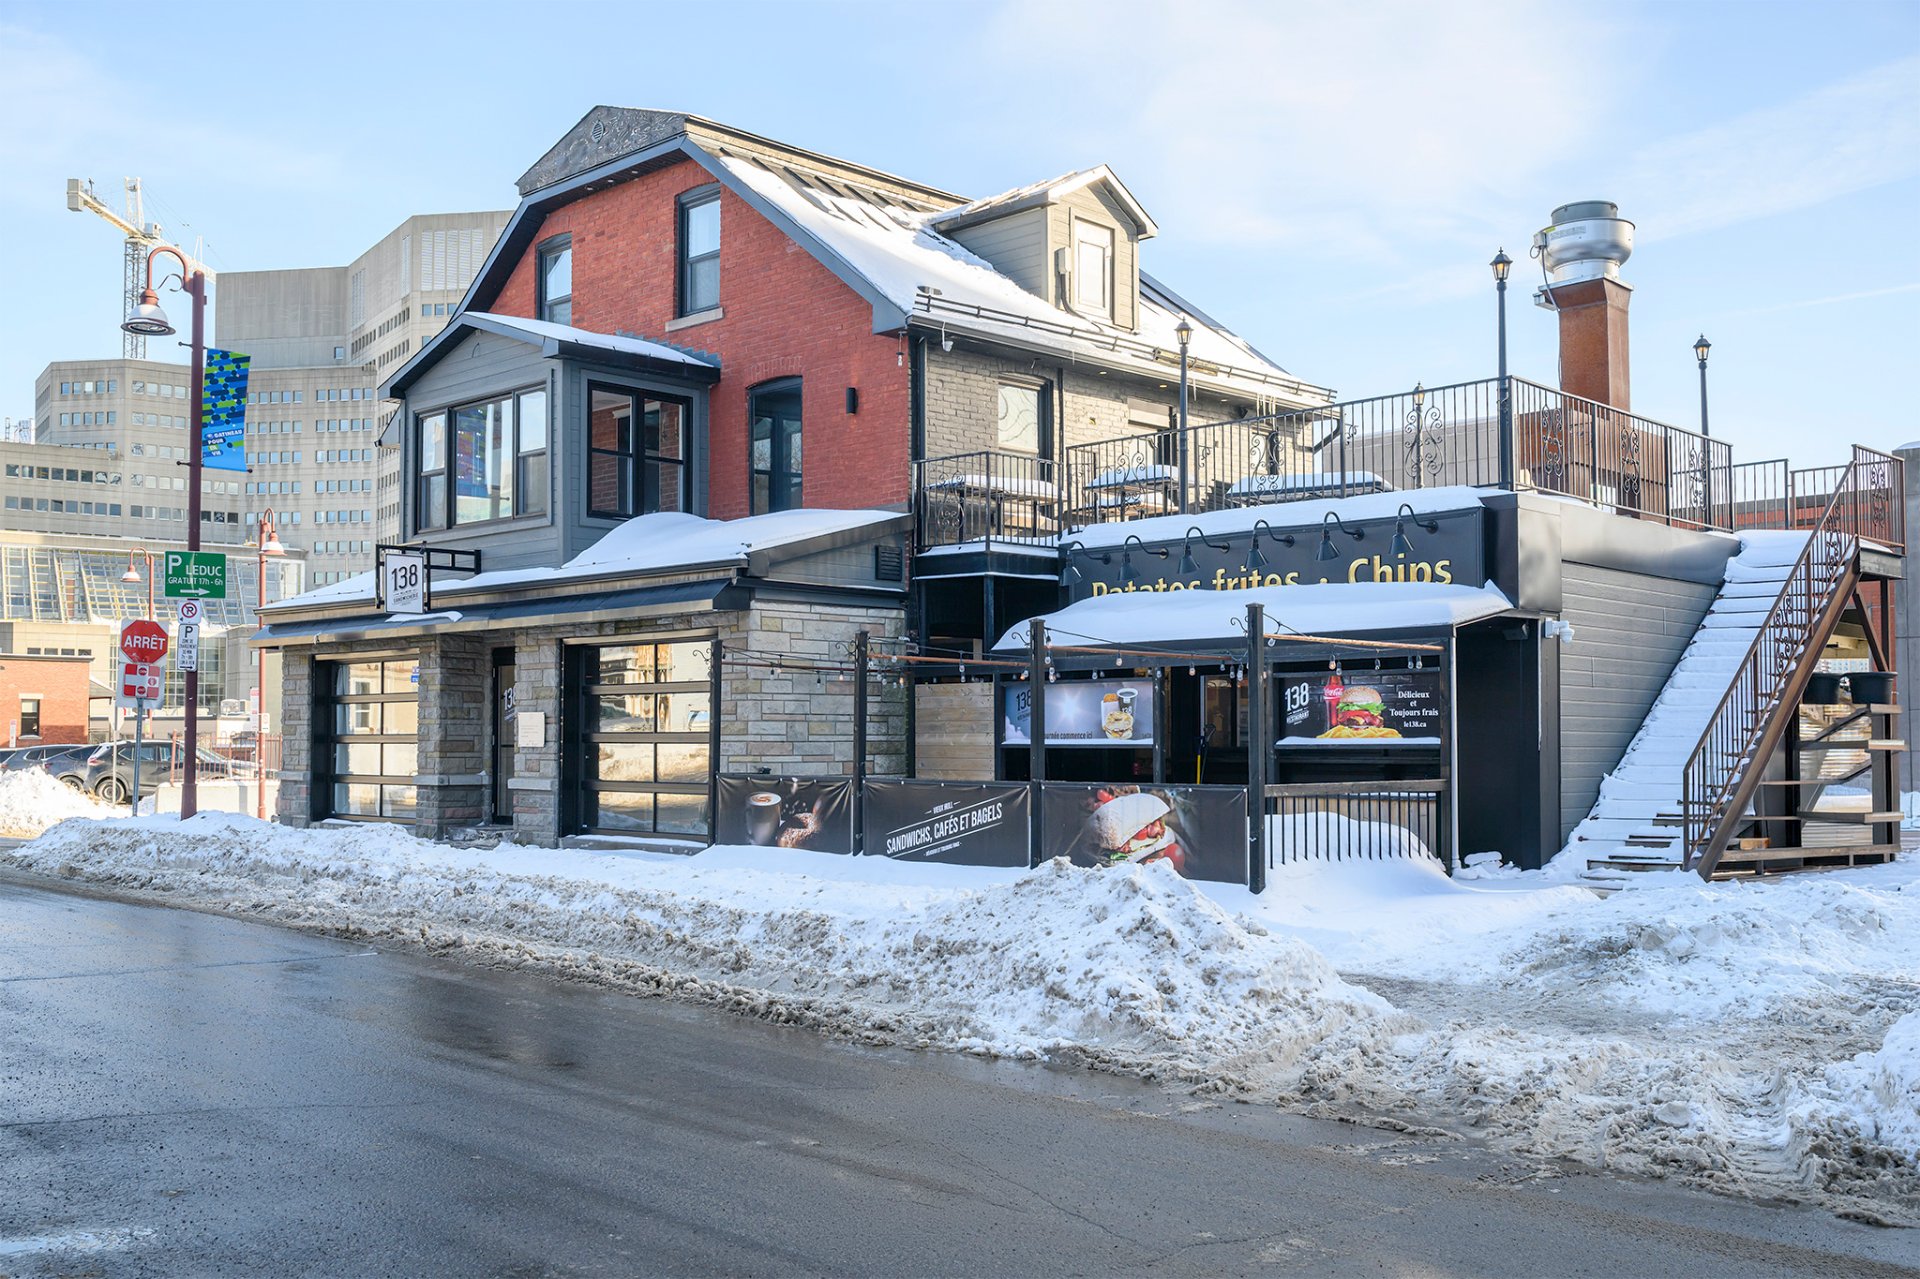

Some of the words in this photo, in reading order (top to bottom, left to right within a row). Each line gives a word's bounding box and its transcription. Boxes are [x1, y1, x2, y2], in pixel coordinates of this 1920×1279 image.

[168, 554, 182, 575] P
[186, 565, 222, 577] LEDUC
[1348, 553, 1452, 585] Chips
[168, 576, 197, 585] GRATUIT
[198, 577, 210, 585] 17h
[214, 578, 223, 586] 6h
[391, 563, 418, 591] 138
[124, 634, 166, 650] ARRÊT
[1284, 682, 1310, 711] 138
[1398, 690, 1430, 699] Délicieux
[1390, 709, 1421, 718] Toujours
[1421, 708, 1439, 716] frais
[1403, 720, 1427, 728] le138.ca
[886, 825, 933, 855] SANDWICHS,
[933, 814, 959, 839] CAFÉS
[959, 811, 970, 831] ET
[971, 802, 1003, 828] BAGELS
